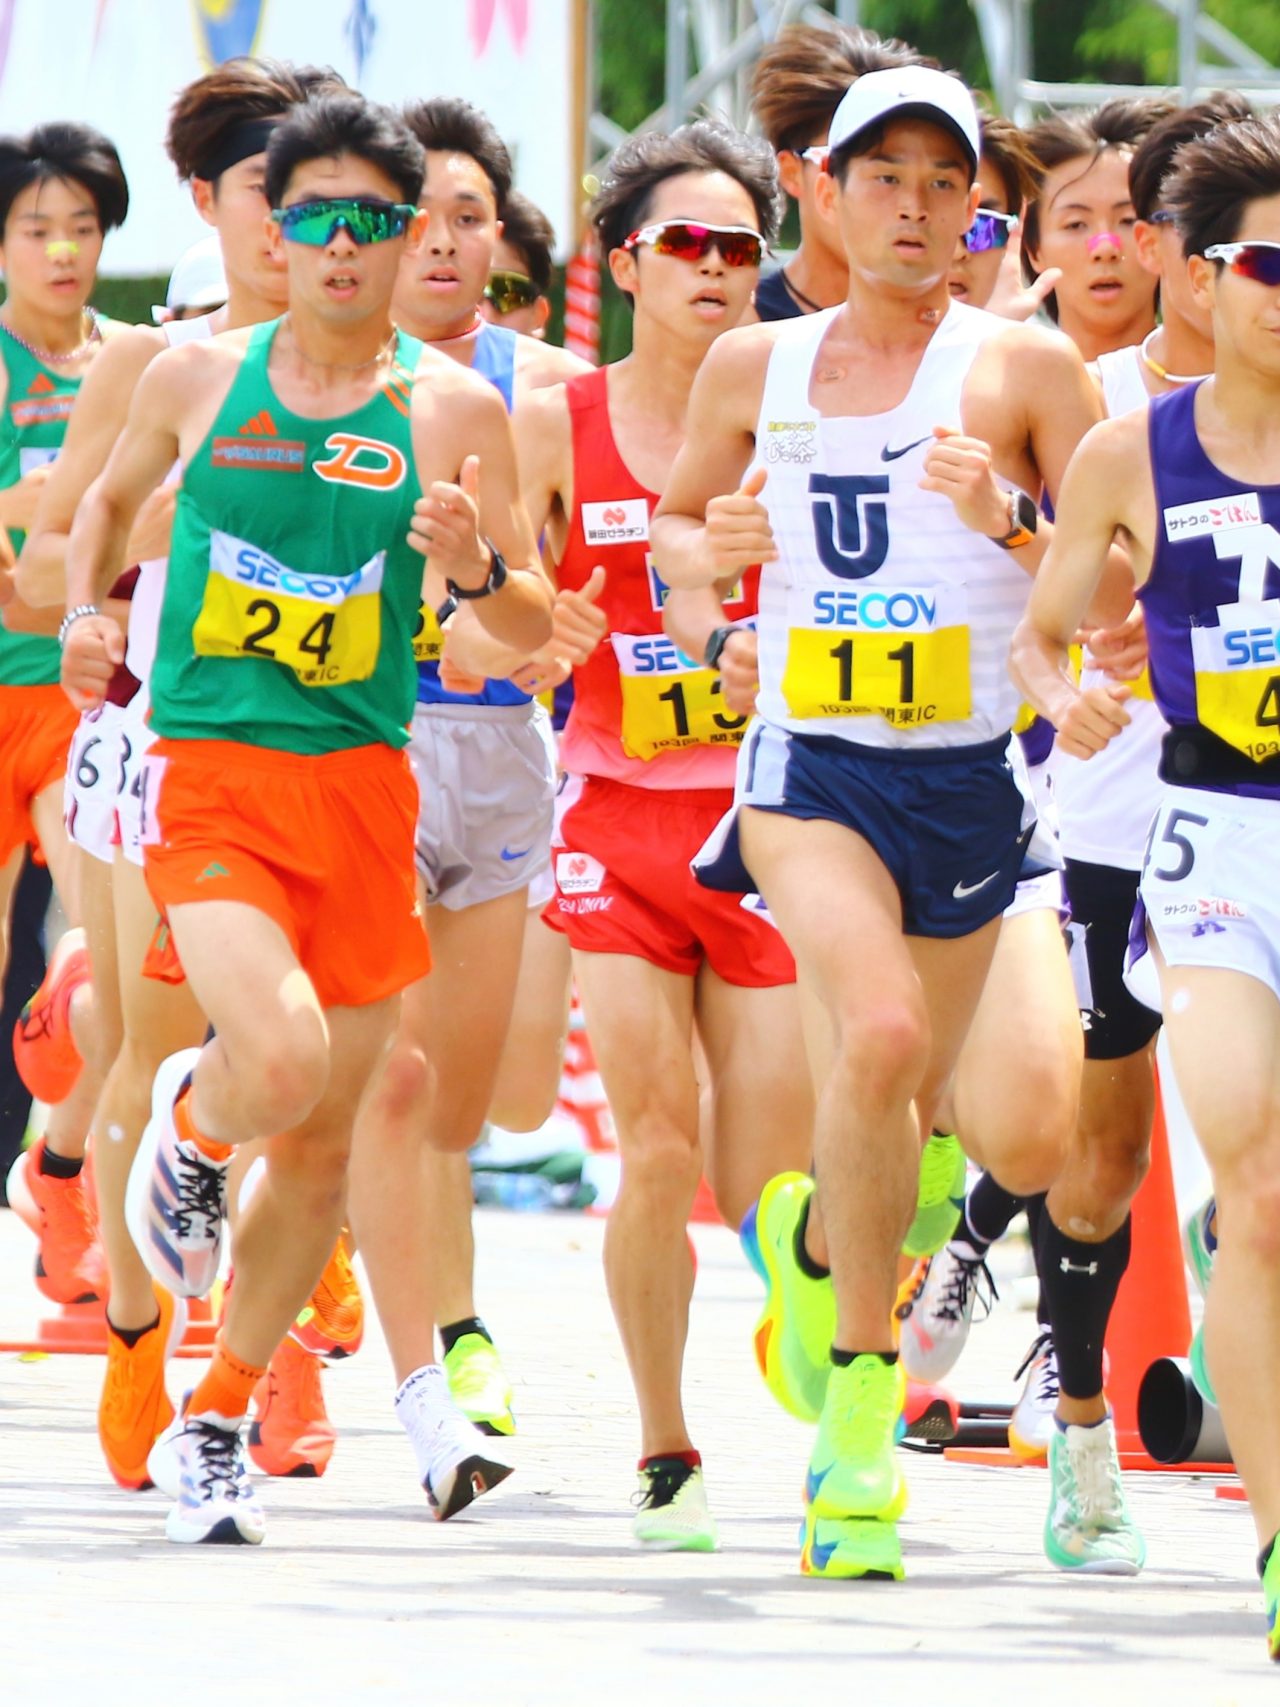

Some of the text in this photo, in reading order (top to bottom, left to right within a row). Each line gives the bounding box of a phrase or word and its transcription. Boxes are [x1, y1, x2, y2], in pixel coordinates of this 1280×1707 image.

[312, 432, 407, 491] D
[1168, 498, 1259, 531] サトウのごはん
[243, 599, 336, 665] 24
[298, 665, 340, 682] 東IC
[829, 639, 914, 703] 11
[659, 681, 749, 737] 13
